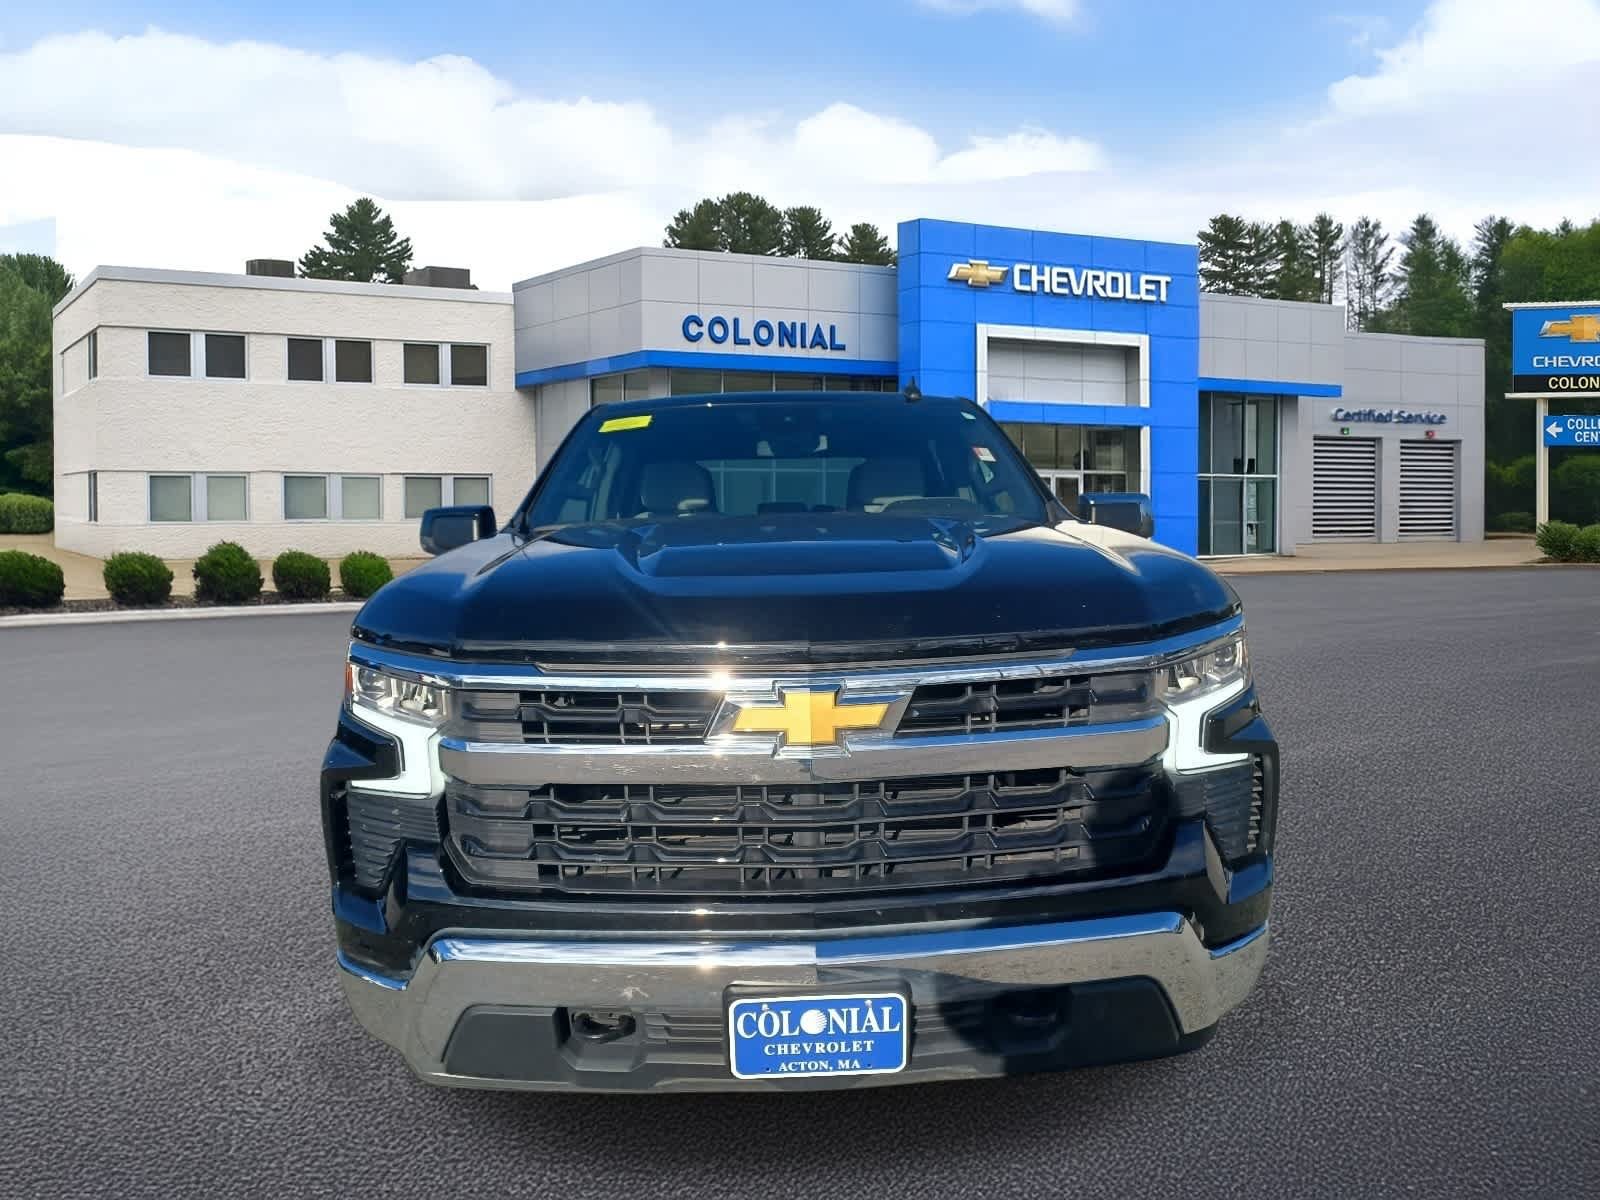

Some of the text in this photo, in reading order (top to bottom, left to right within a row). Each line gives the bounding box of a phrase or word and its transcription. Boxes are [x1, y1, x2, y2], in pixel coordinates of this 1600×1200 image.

[1013, 263, 1172, 302] CHEVROLET
[682, 314, 846, 351] COLONIAL
[1331, 408, 1447, 425] Certified Service
[1574, 431, 1600, 443] CEN
[764, 1040, 875, 1056] CHEVROLET
[778, 1059, 861, 1073] ACTON, MA
